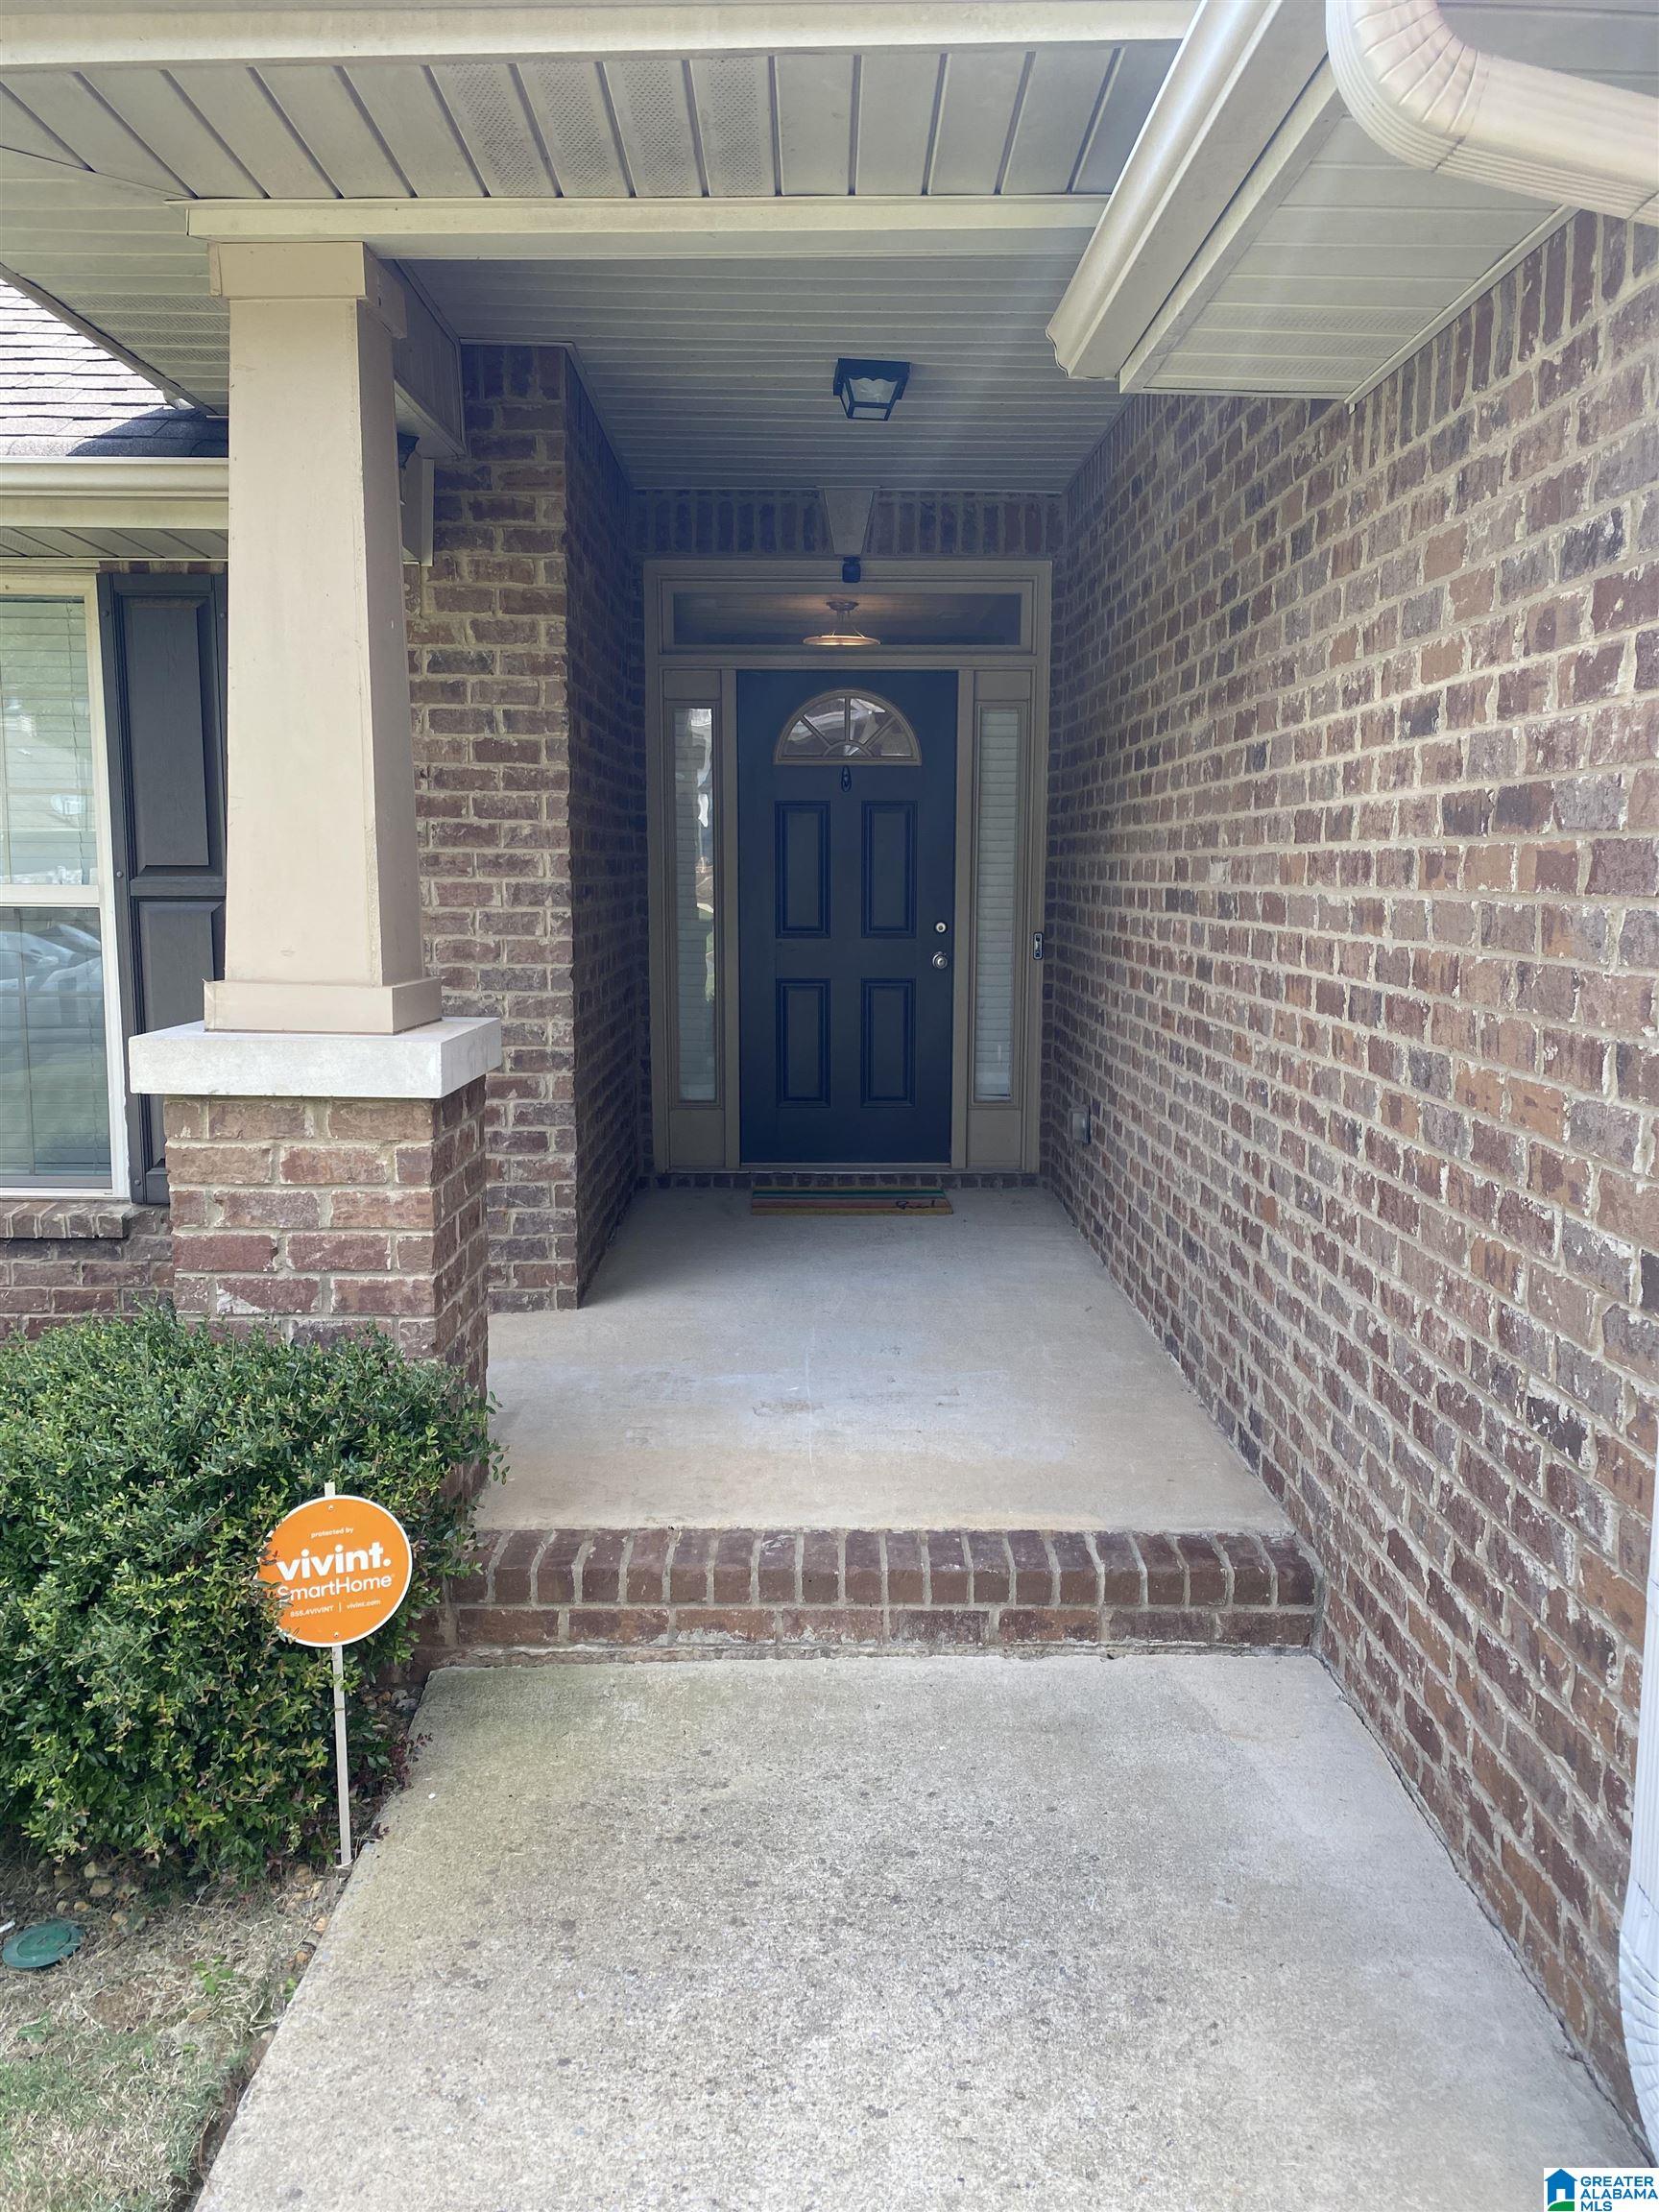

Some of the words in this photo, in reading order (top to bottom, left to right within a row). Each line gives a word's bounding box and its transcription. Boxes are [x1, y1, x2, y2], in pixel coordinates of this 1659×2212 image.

[310, 1527, 344, 1539] protected
[345, 1526, 354, 1535] by
[276, 1542, 391, 1581] vivint.
[276, 1575, 393, 1602] SmartHome
